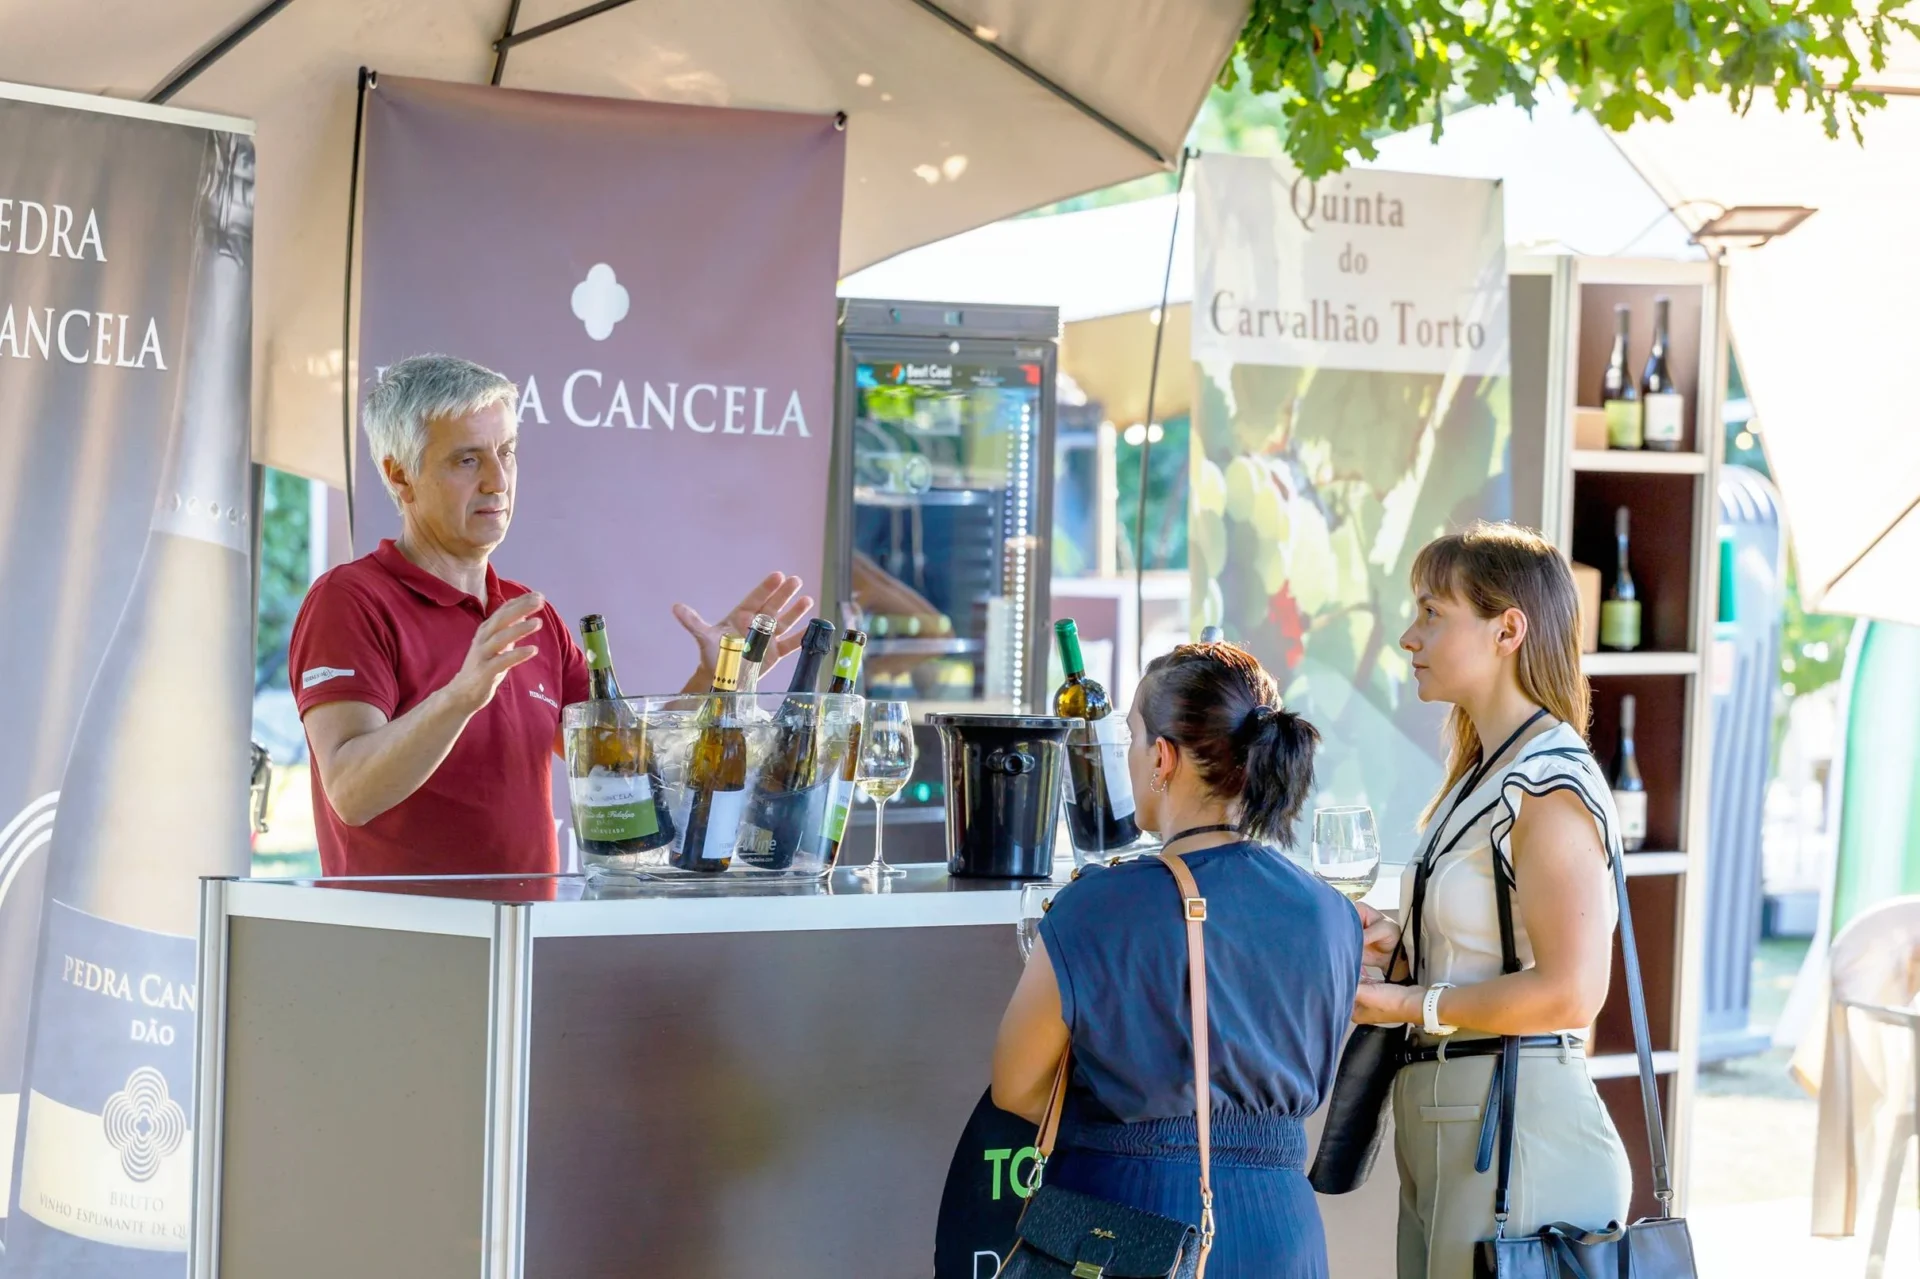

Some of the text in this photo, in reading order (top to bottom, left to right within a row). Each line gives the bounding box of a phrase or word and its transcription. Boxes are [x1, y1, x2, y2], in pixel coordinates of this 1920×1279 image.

[0, 198, 107, 262] EDRA
[1290, 174, 1405, 232] Quinta
[1338, 242, 1369, 275] do
[0, 303, 168, 370] ANCELA
[1210, 290, 1485, 351] Carvalhão Torto
[562, 369, 812, 438] CANCELA
[62, 953, 196, 1012] PEDRA CAN
[131, 1018, 175, 1046] DÃO
[39, 1191, 72, 1217] VINHO
[76, 1207, 147, 1236] ESPUMANTE
[151, 1221, 168, 1237] DE
[110, 1191, 164, 1212] BRUTO
